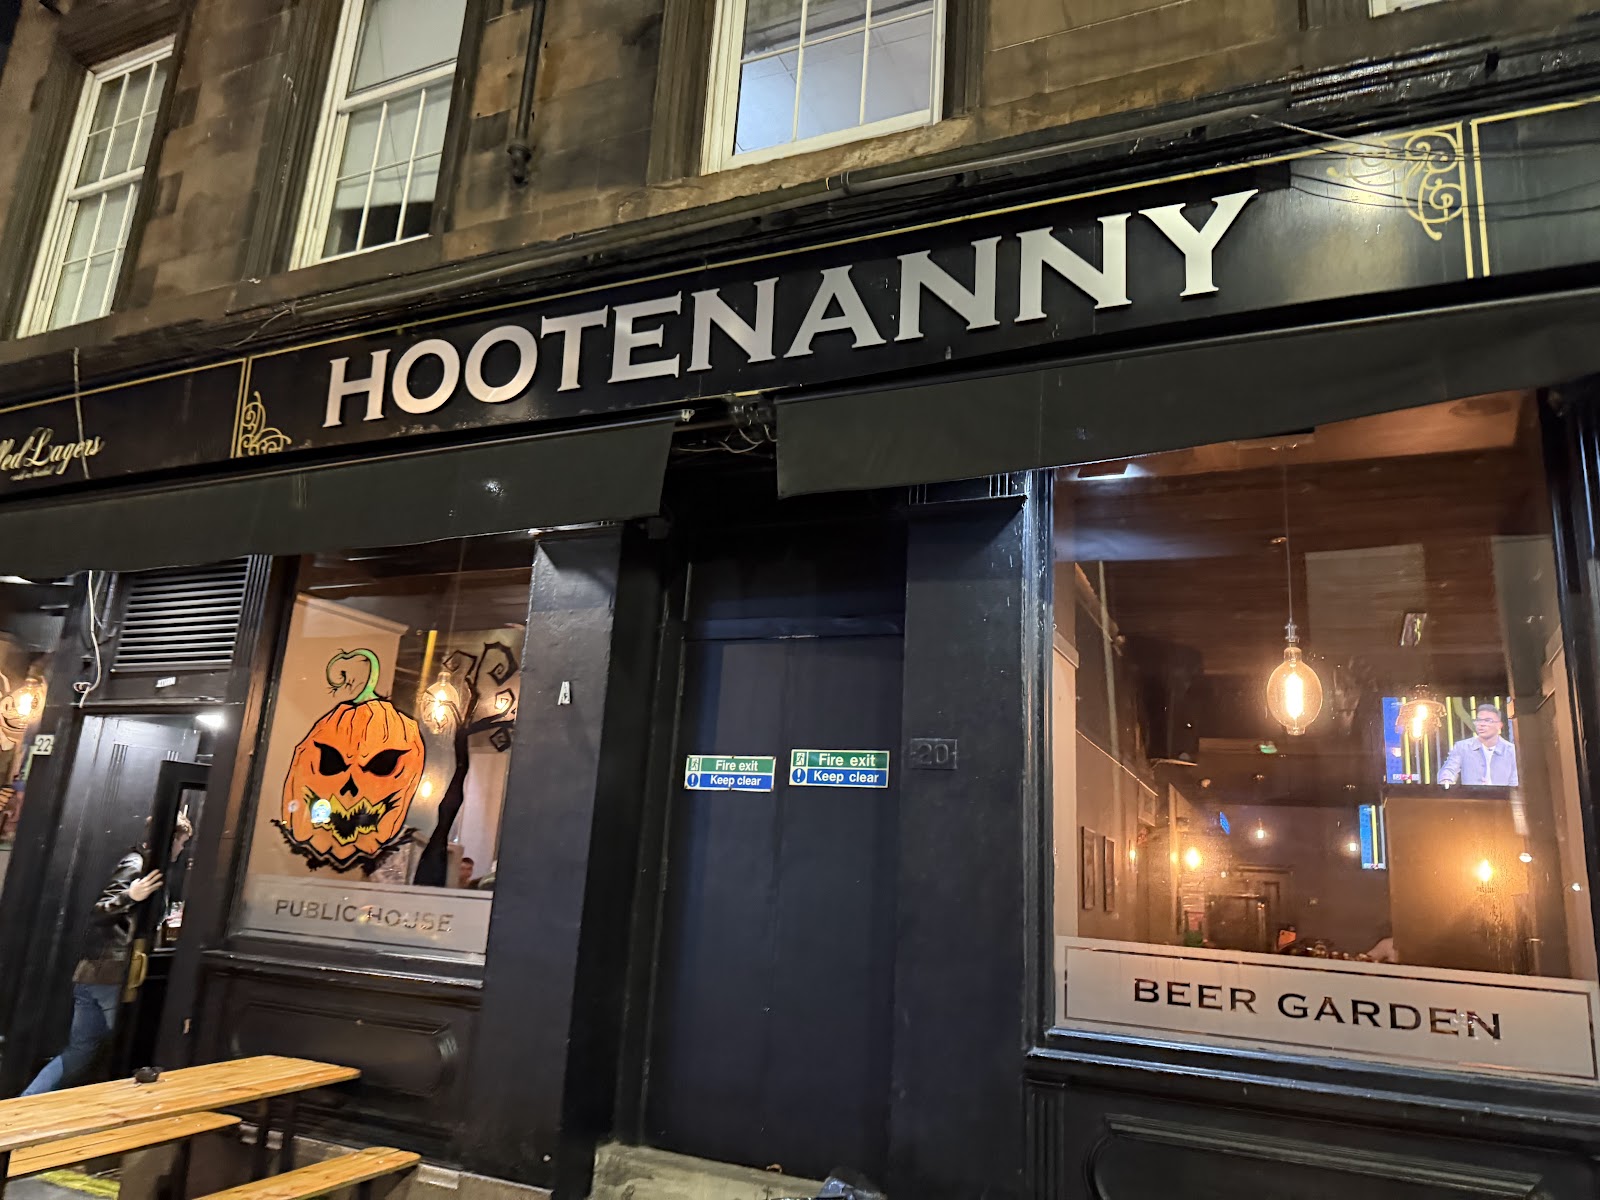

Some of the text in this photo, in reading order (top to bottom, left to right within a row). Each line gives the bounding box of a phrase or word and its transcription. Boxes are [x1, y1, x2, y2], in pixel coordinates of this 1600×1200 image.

[322, 188, 1258, 428] HOOTENANNY
[23, 426, 105, 475] Lagers
[36, 737, 52, 752] 22
[818, 753, 876, 768] Fire exit
[917, 743, 949, 765] 20
[715, 759, 759, 772] Fire exit
[710, 774, 762, 787] Keep clear
[813, 770, 880, 784] Keep clear
[275, 899, 453, 932] PUBLIC HOUSE
[1134, 977, 1502, 1040] BEER GARDEN
